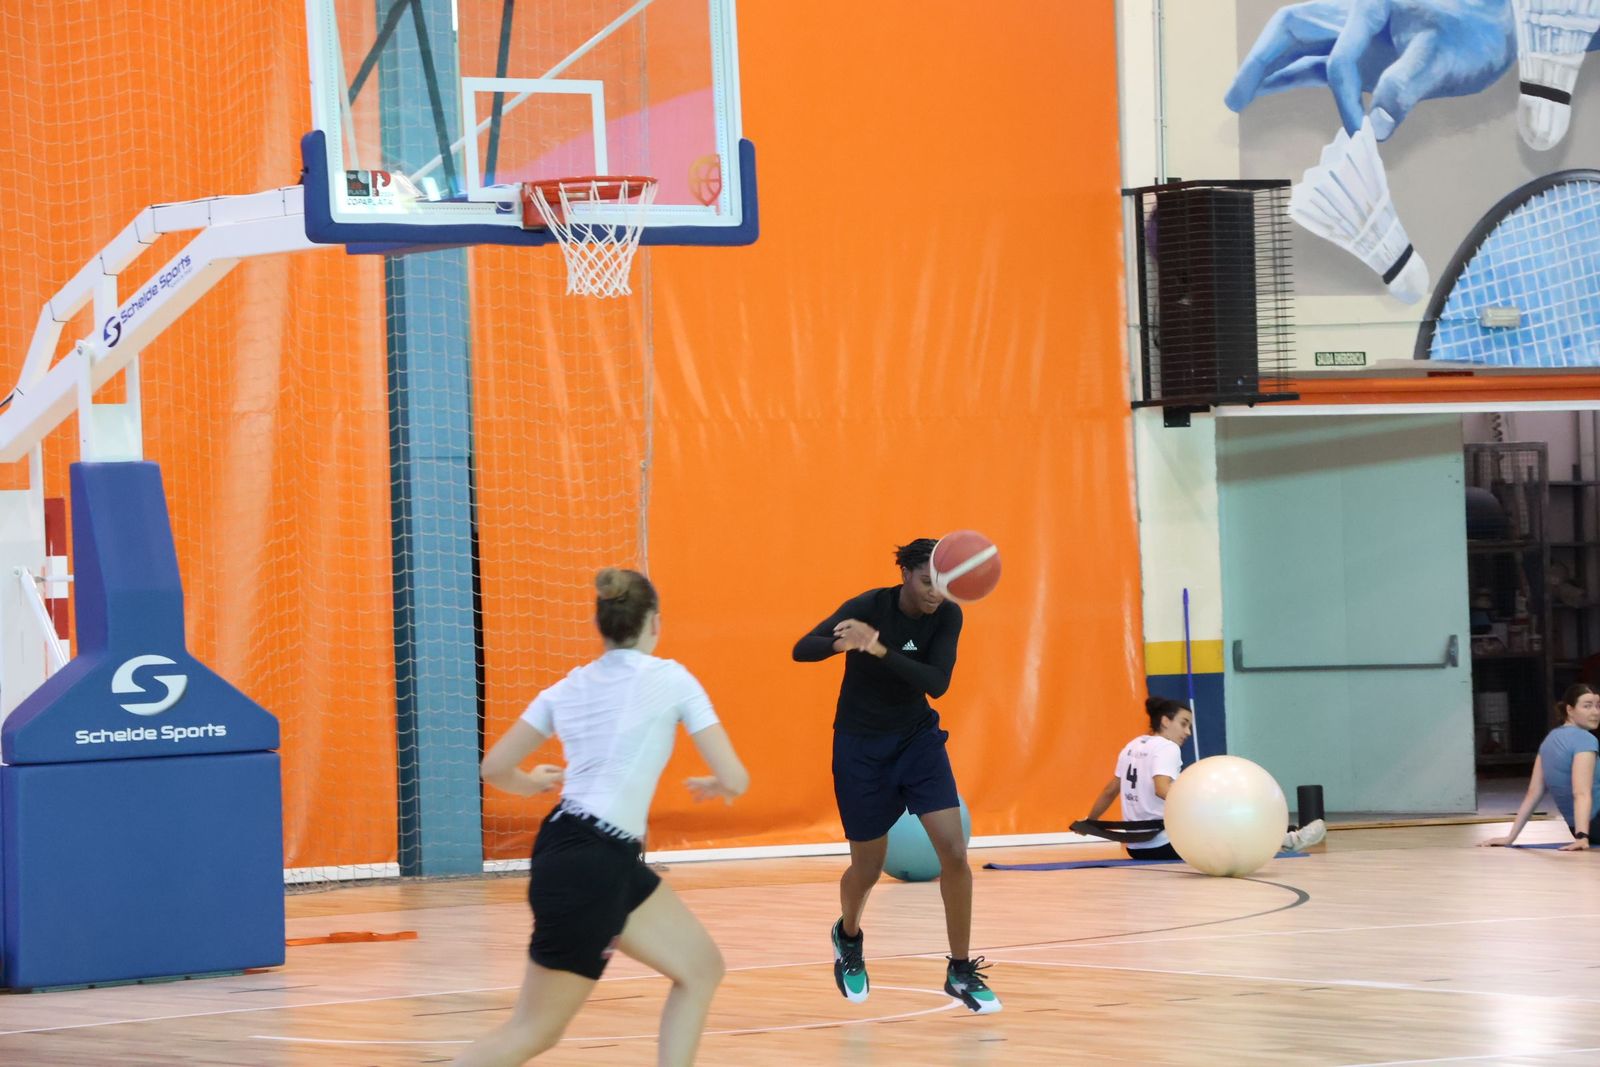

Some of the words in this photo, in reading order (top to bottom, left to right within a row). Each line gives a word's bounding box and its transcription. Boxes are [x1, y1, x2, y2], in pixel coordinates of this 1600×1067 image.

[120, 284, 159, 324] Schelde
[159, 254, 191, 289] Sports
[75, 727, 158, 745] Schelde
[160, 723, 227, 743] Sports
[1126, 763, 1137, 789] 4
